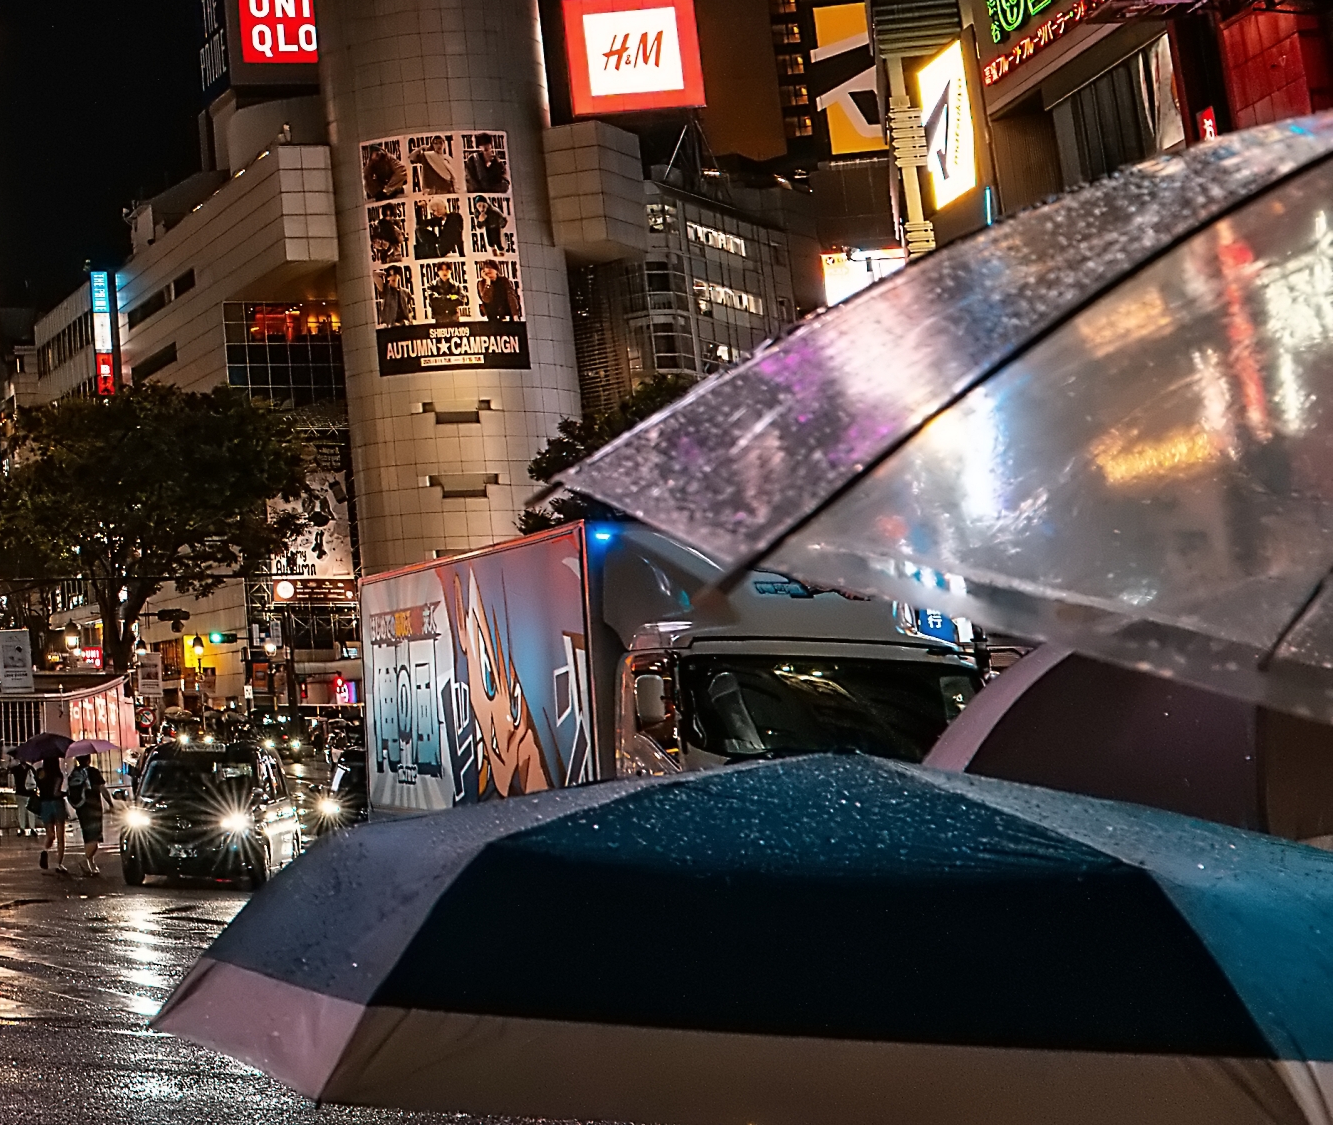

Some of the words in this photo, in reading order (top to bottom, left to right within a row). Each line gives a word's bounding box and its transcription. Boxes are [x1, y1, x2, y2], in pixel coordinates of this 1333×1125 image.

[251, 23, 318, 58] QLO
[601, 29, 664, 71] H&M
[387, 339, 437, 359] AUTUMN
[451, 336, 519, 355] CAMPAIGN
